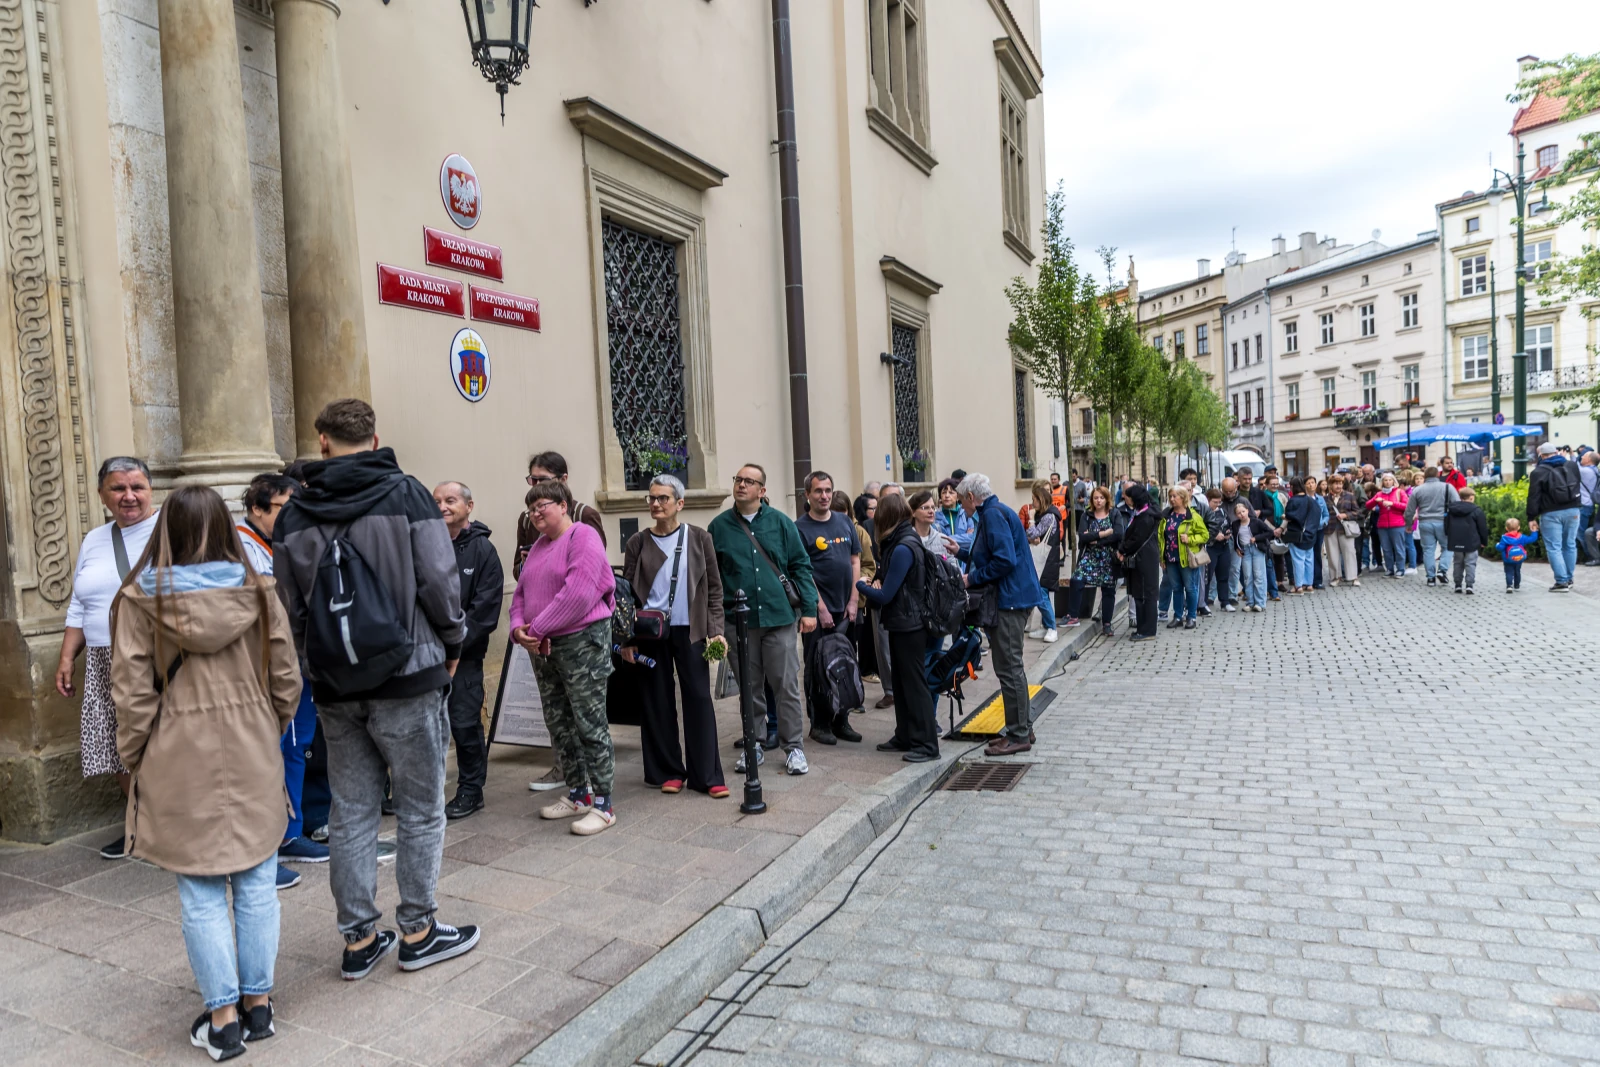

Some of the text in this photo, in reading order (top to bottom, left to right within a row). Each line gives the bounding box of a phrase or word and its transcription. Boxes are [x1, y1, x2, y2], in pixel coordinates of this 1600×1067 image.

[441, 237, 493, 260] URZĄD MIASTA
[450, 252, 486, 271] KRAKOWA
[399, 274, 451, 295] RADA MIASTA
[407, 290, 446, 307] KRAKOWA
[475, 291, 538, 314] PREZYDENT MIASTA
[493, 307, 525, 323] KRAKOWA
